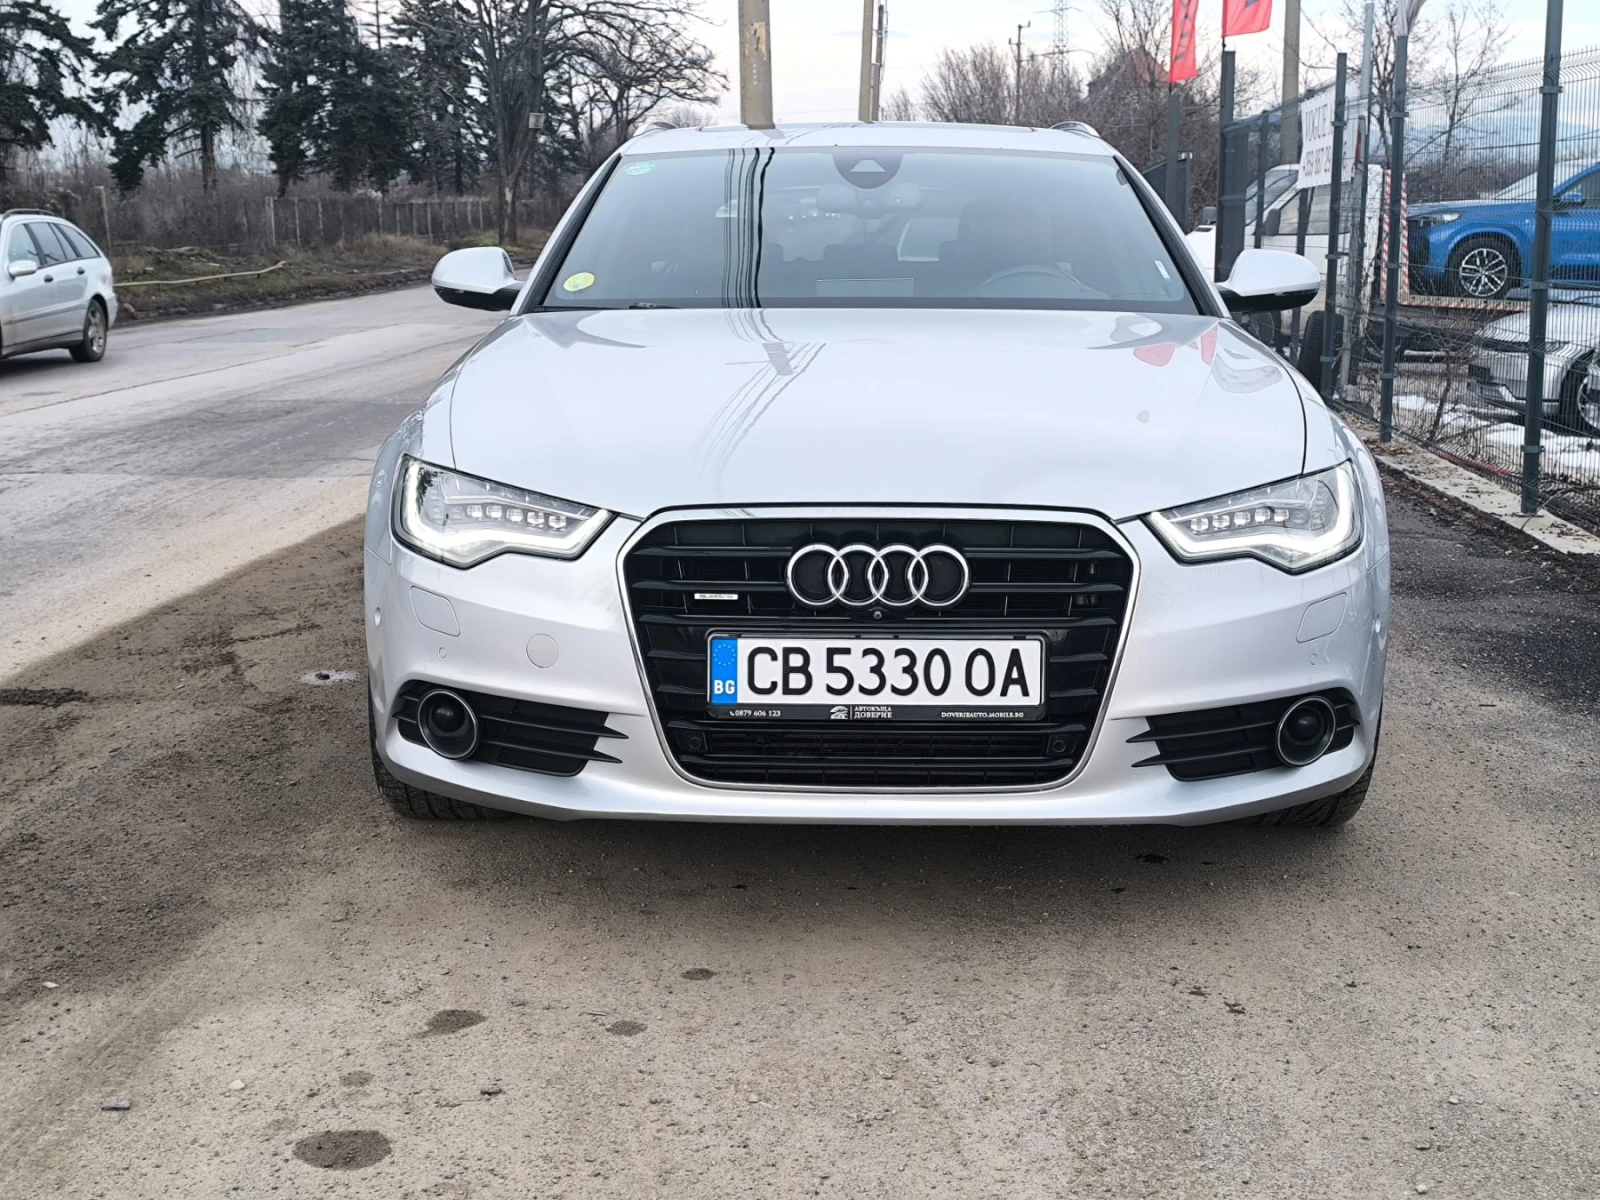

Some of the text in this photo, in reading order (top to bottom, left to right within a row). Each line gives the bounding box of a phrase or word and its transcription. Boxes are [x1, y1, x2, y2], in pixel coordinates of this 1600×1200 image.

[747, 646, 1030, 697] CB 5330 OA
[714, 680, 735, 694] BG
[735, 709, 752, 717] 0879
[754, 709, 767, 717] 606
[854, 711, 892, 719] ДОВЕРИЕ
